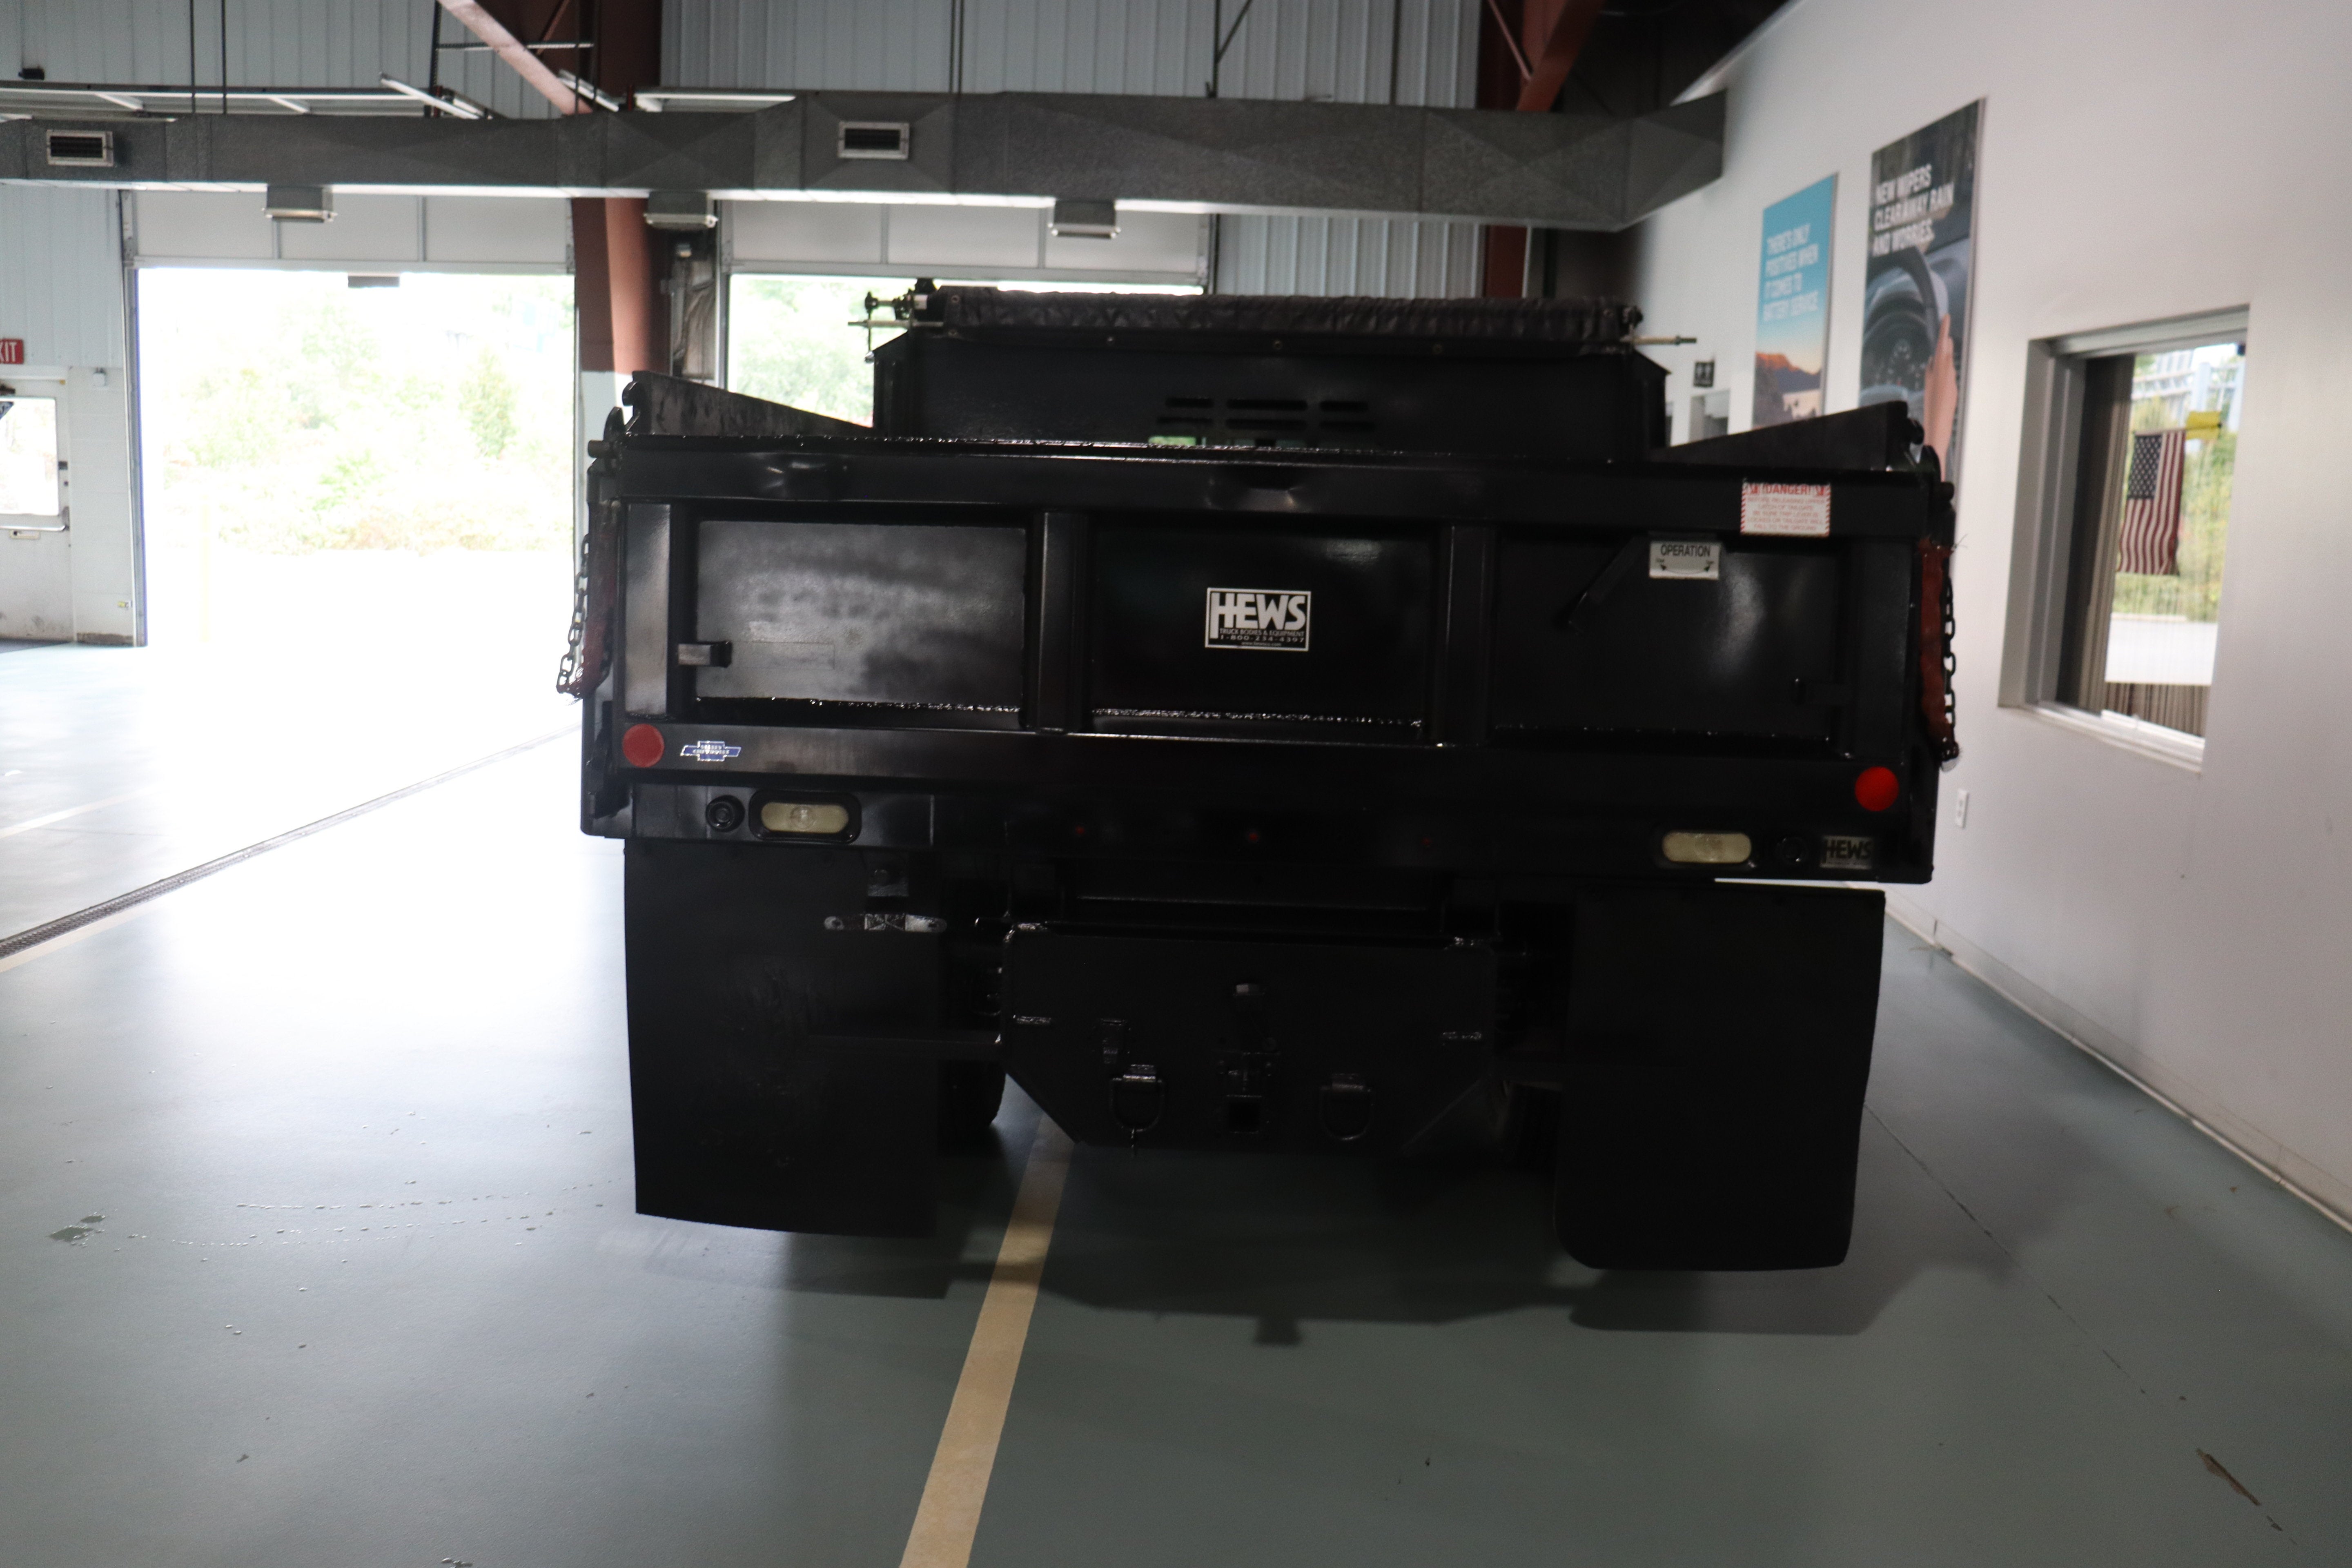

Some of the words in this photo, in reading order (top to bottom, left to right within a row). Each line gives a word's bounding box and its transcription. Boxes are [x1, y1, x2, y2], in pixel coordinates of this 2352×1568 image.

[1876, 179, 1895, 205] NEW
[1897, 163, 1932, 198] WIPERS
[1929, 182, 1955, 212] RAIN
[1793, 223, 1811, 249] ONLY
[1871, 232, 1890, 256] AND
[1798, 243, 1819, 268] WHEN
[1661, 545, 1710, 557] OPERATION
[1209, 592, 1306, 639] HEWS
[1823, 840, 1873, 863] HEWS
